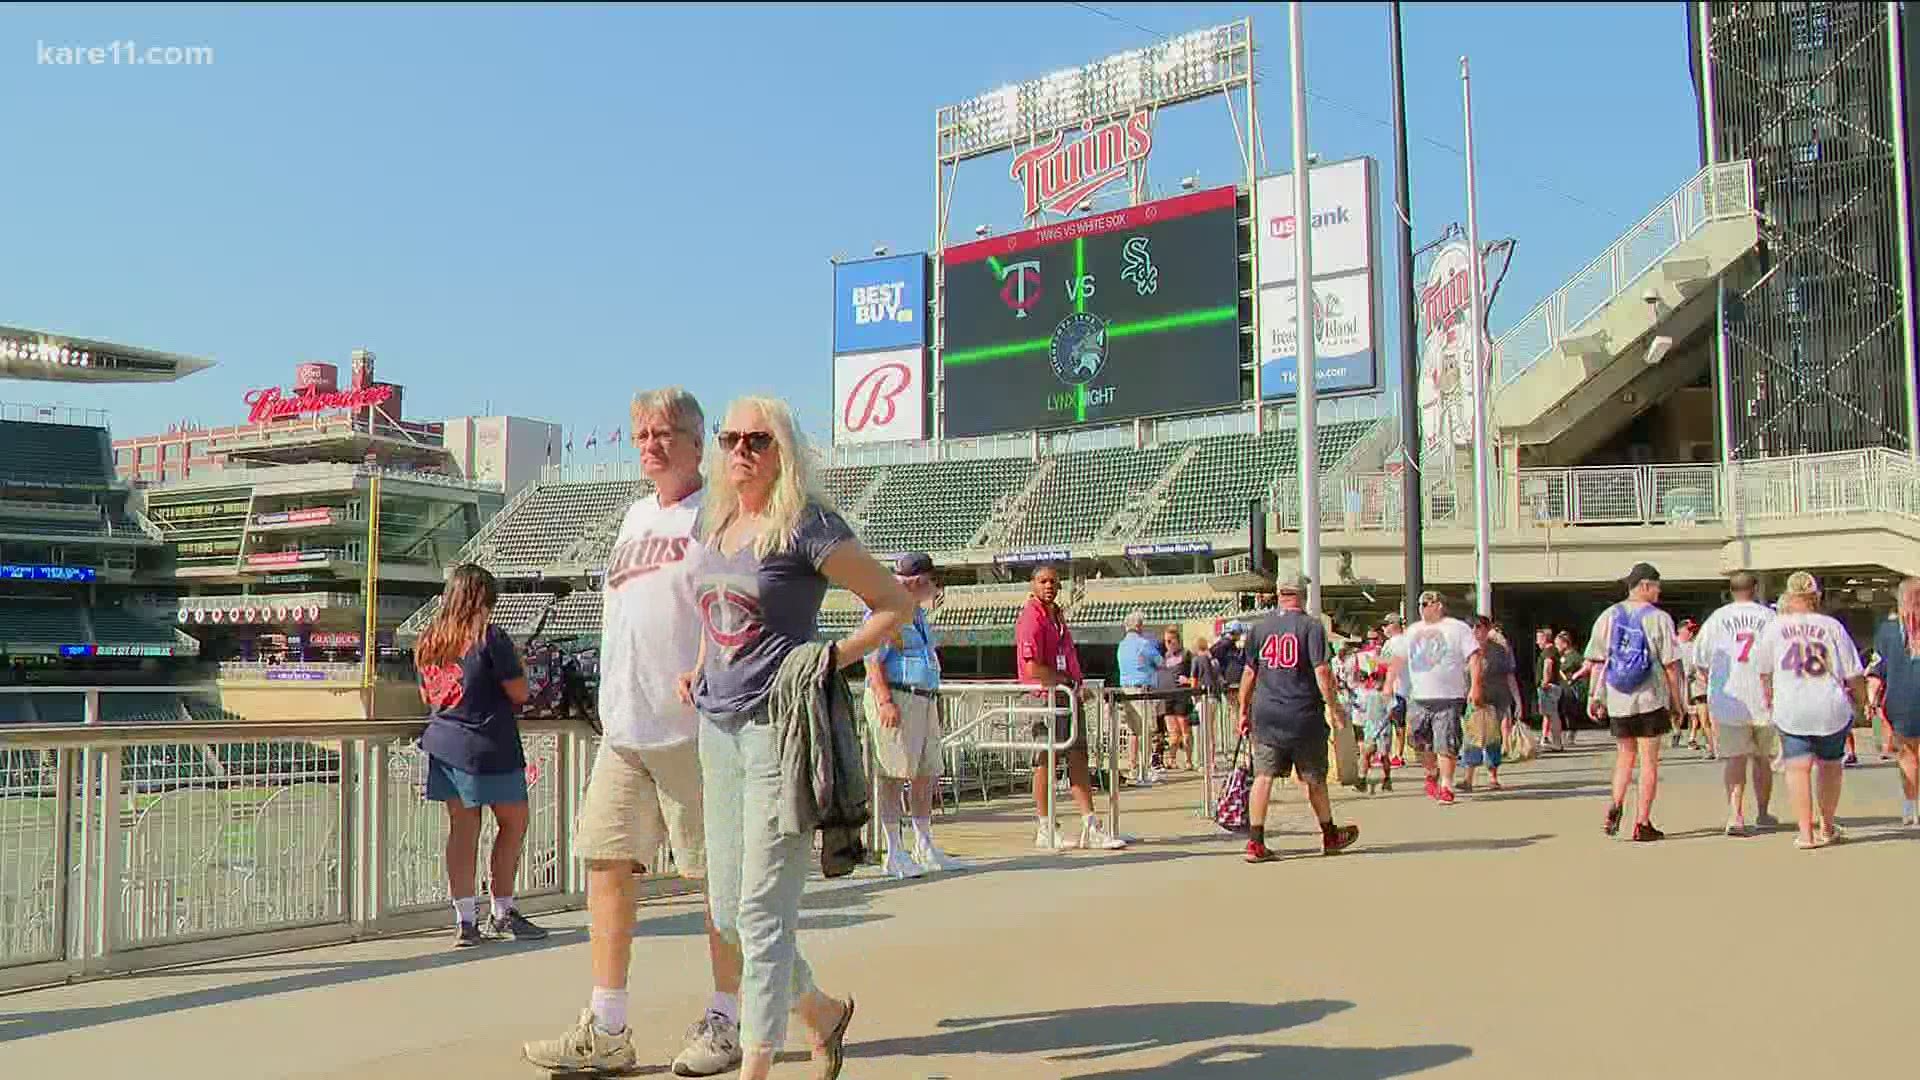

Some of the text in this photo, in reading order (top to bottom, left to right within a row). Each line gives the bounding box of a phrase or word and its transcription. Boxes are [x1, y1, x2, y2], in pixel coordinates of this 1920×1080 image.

[1010, 110, 1152, 217] Twins
[1036, 214, 1127, 242] TWINS VS WHITE SOX
[1311, 206, 1349, 230] ank
[852, 281, 904, 308] BEST
[1064, 275, 1096, 302] VS
[856, 303, 898, 325] BUY
[1048, 386, 1117, 411] LYNX IGHT
[1259, 632, 1298, 668] 40
[1736, 632, 1755, 662] 7
[1781, 642, 1827, 676] 48
